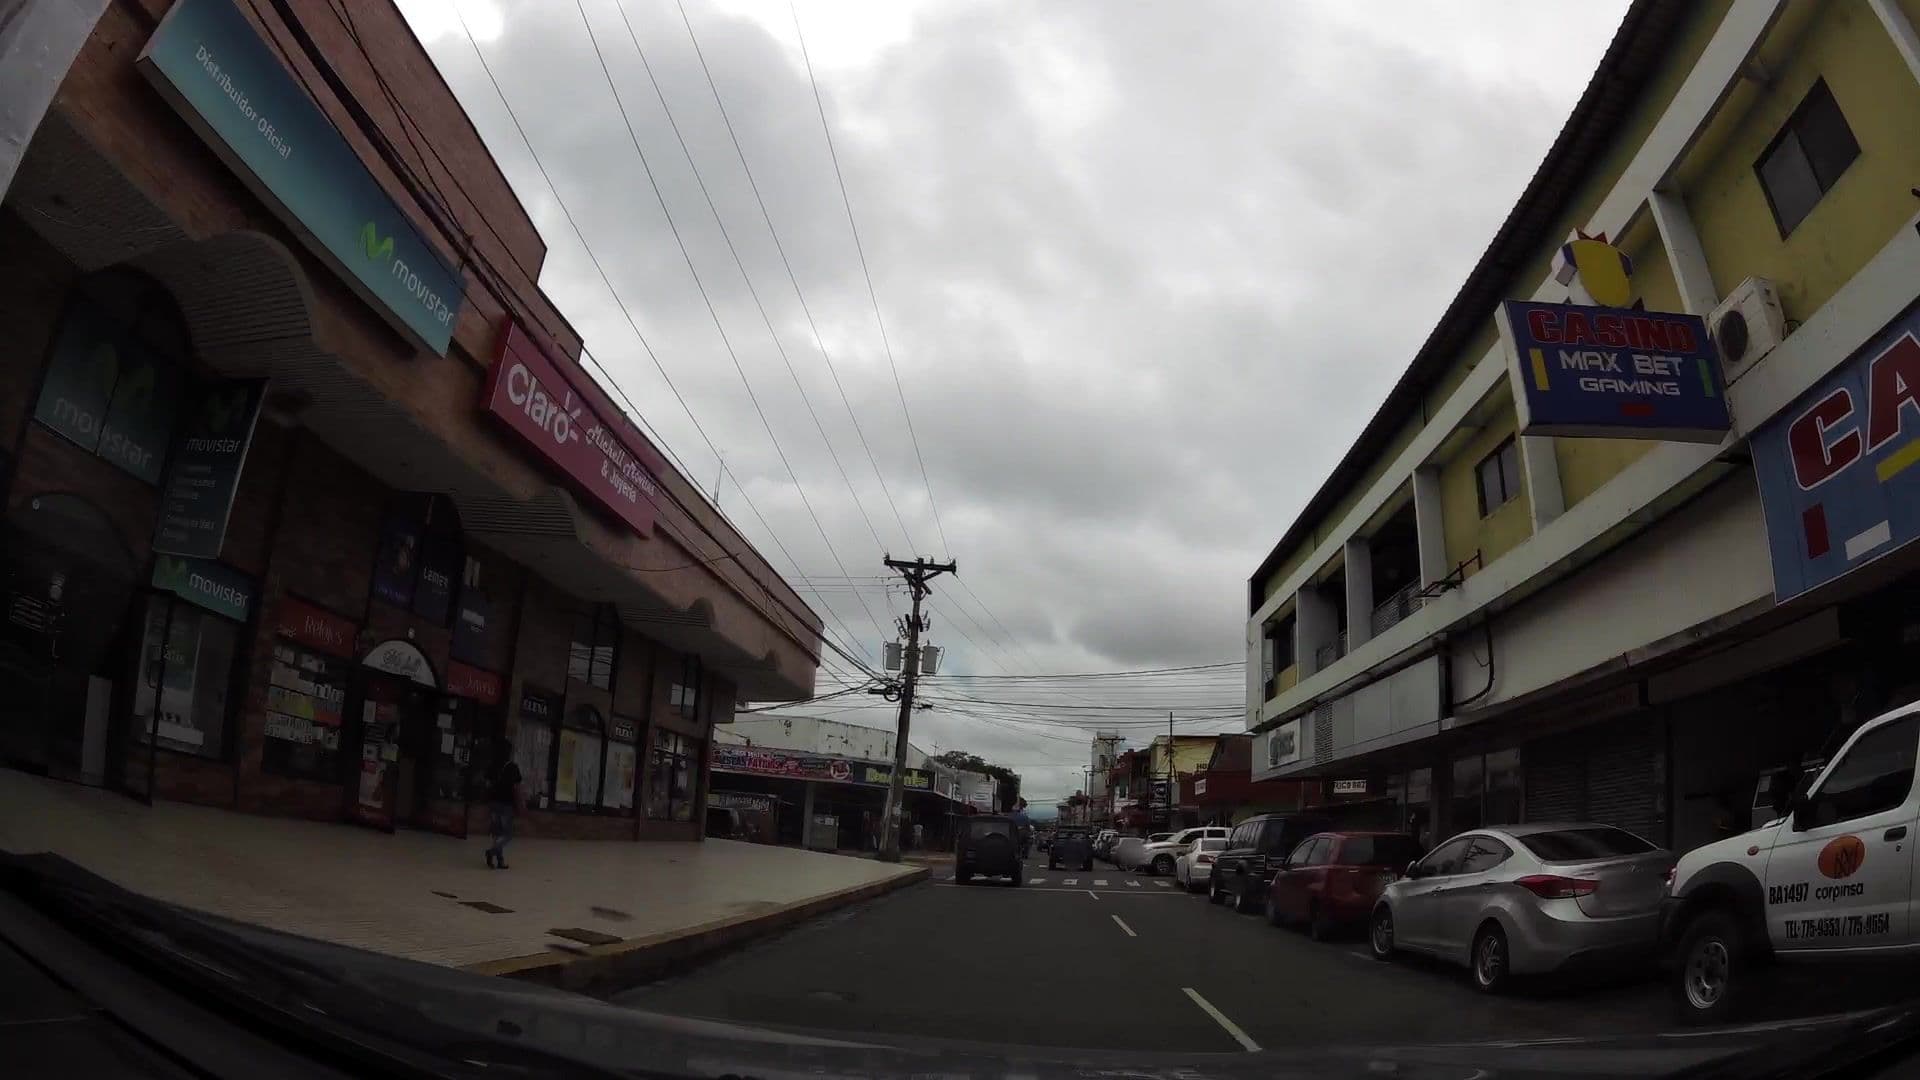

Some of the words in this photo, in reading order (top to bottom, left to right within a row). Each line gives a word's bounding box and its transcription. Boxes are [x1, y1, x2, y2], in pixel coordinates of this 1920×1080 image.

[195, 44, 259, 123] Distribuidor
[256, 116, 292, 161] Oficial
[391, 258, 454, 327] movistar
[1527, 309, 1697, 354] CASINO
[1559, 350, 1622, 374] MAX
[1634, 354, 1683, 378] BET
[506, 363, 570, 445] Claro
[1578, 376, 1681, 397] GAMING
[54, 397, 153, 470] movistar
[185, 437, 241, 456] movistar
[601, 459, 609, 480] &
[188, 572, 249, 609] movistar
[1769, 883, 1809, 905] BA1497
[1815, 883, 1864, 903] corpinsa
